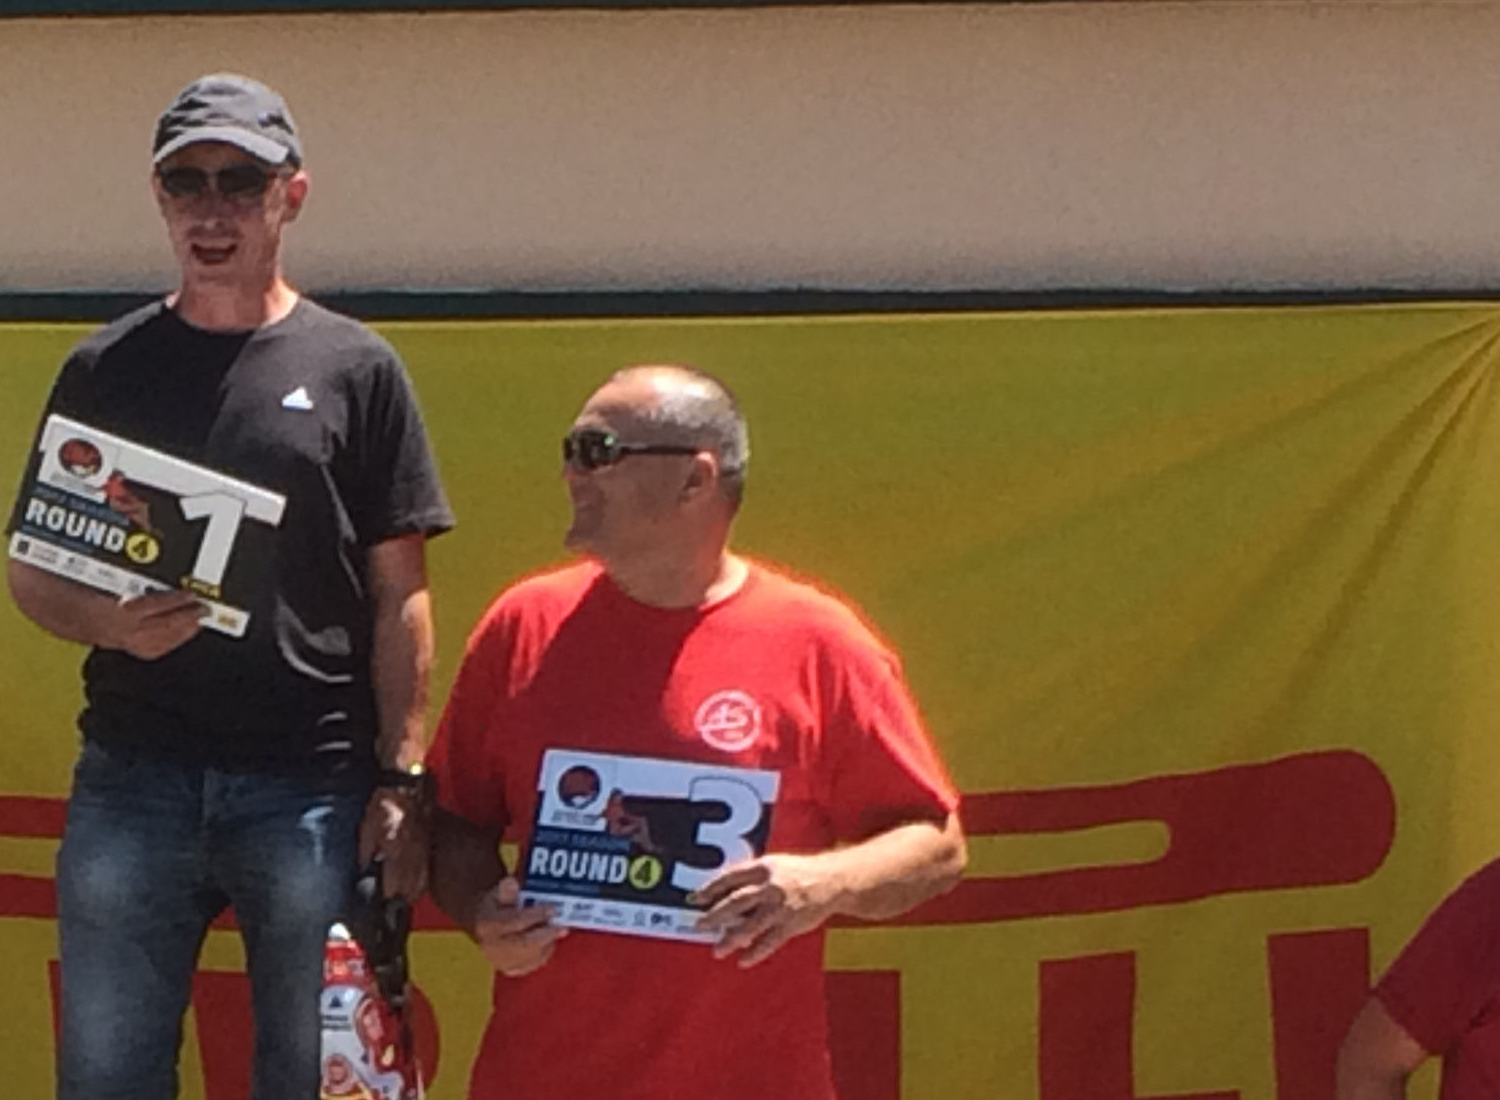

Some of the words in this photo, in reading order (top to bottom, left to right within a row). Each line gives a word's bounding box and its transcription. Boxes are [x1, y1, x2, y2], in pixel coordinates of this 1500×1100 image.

[25, 497, 127, 554] ROUND
[179, 491, 247, 585] 1
[529, 846, 629, 884] ROUND
[633, 859, 654, 886] 4
[670, 776, 763, 892] 3
